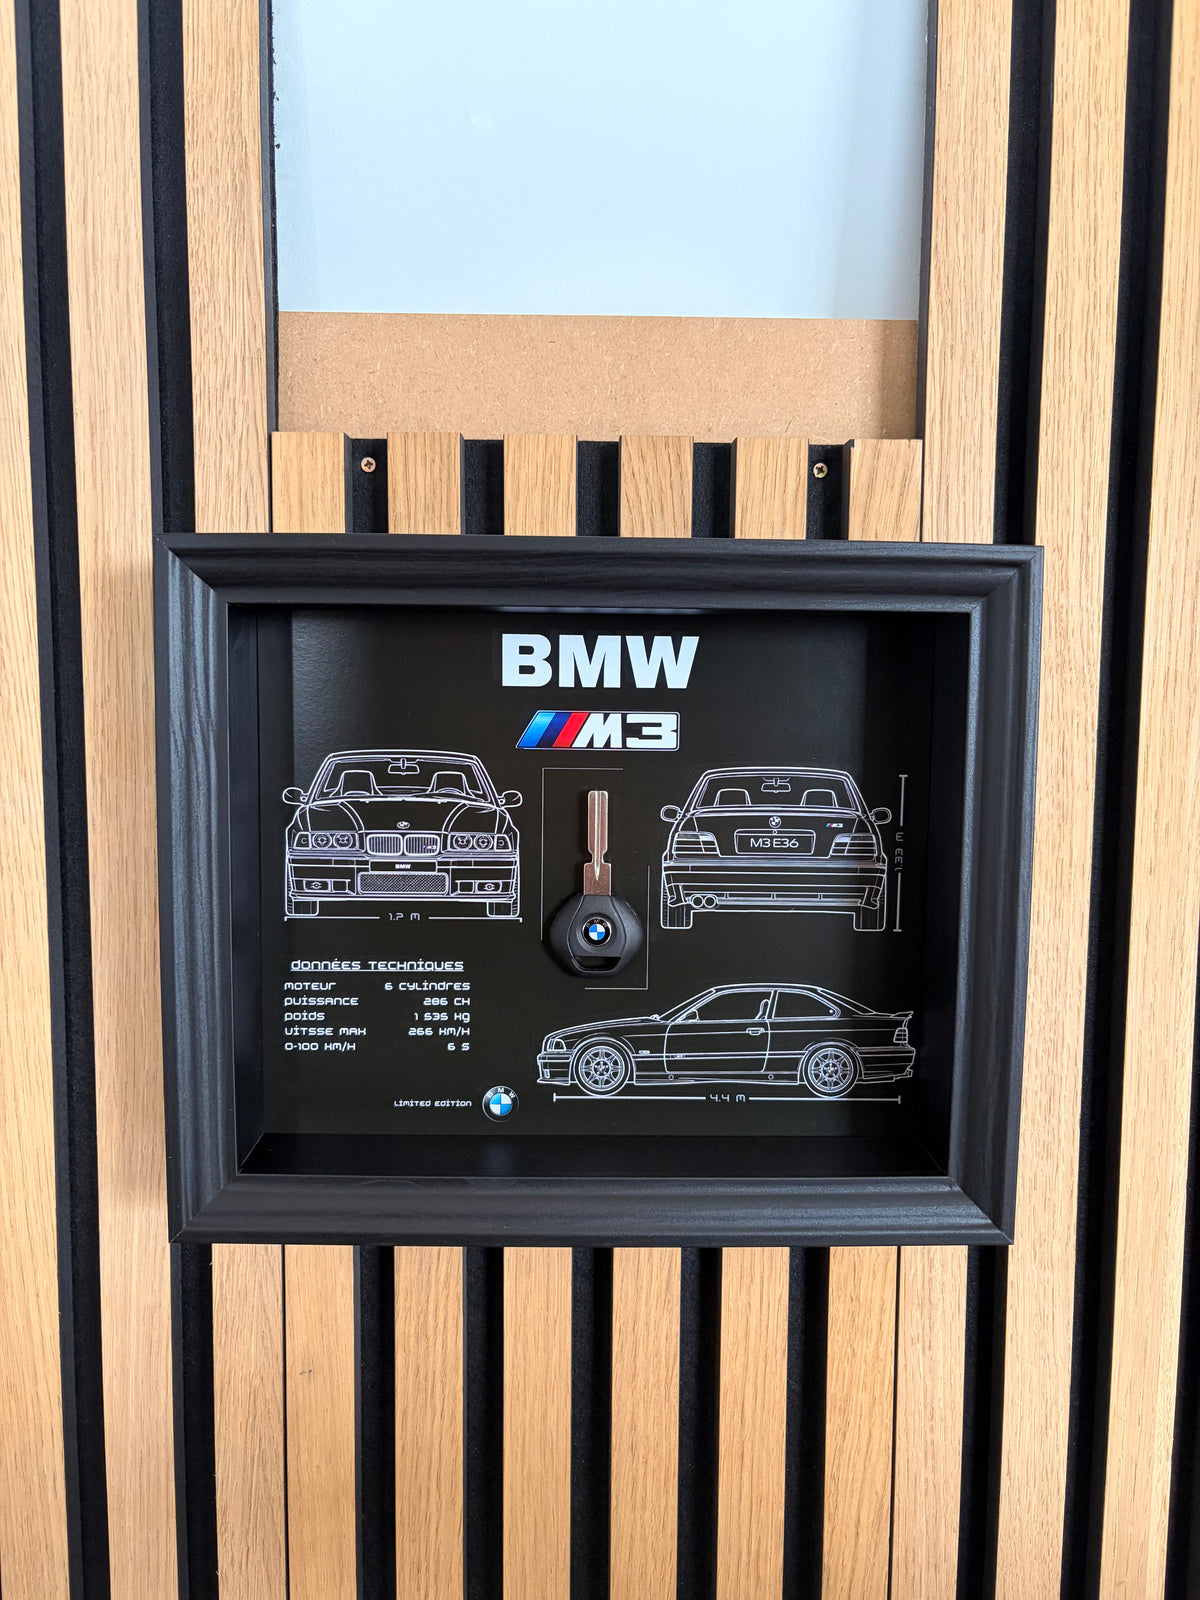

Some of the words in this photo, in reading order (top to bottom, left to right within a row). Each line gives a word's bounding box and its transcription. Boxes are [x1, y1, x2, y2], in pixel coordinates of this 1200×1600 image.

[502, 633, 700, 689] BMW
[571, 712, 678, 749] M3
[750, 837, 771, 848] M3
[773, 838, 799, 848] E36
[284, 982, 336, 991] MOTEUR
[384, 982, 394, 991] 6
[398, 980, 471, 991] CYLINDRES
[284, 995, 359, 1006] PUISSANCE
[423, 997, 448, 1006] 286
[454, 997, 471, 1006] CH
[413, 1012, 419, 1021] 1
[423, 1012, 449, 1021] 535
[408, 1027, 434, 1036] 266
[284, 1042, 319, 1051] 0-100
[447, 1042, 456, 1051] 6
[461, 1042, 471, 1051] S
[709, 1094, 730, 1103] 4.4
